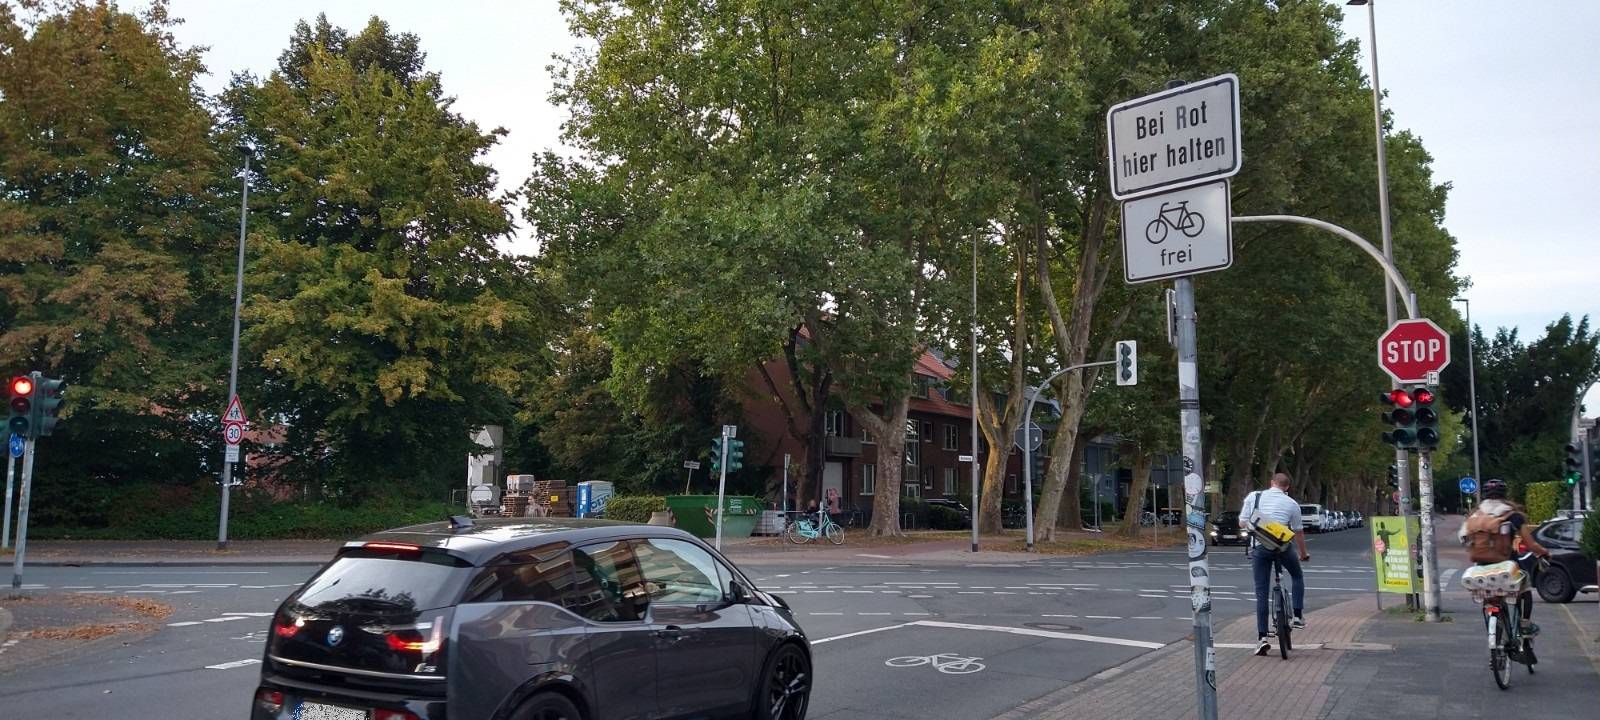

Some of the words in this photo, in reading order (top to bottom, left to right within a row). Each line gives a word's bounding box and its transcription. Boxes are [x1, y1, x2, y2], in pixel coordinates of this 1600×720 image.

[1136, 111, 1164, 140] Bei
[1176, 101, 1208, 130] Rot
[1123, 152, 1157, 178] hier
[1167, 136, 1226, 168] halten
[1160, 244, 1193, 266] frei
[1387, 338, 1441, 363] STOP
[228, 428, 240, 439] 30
